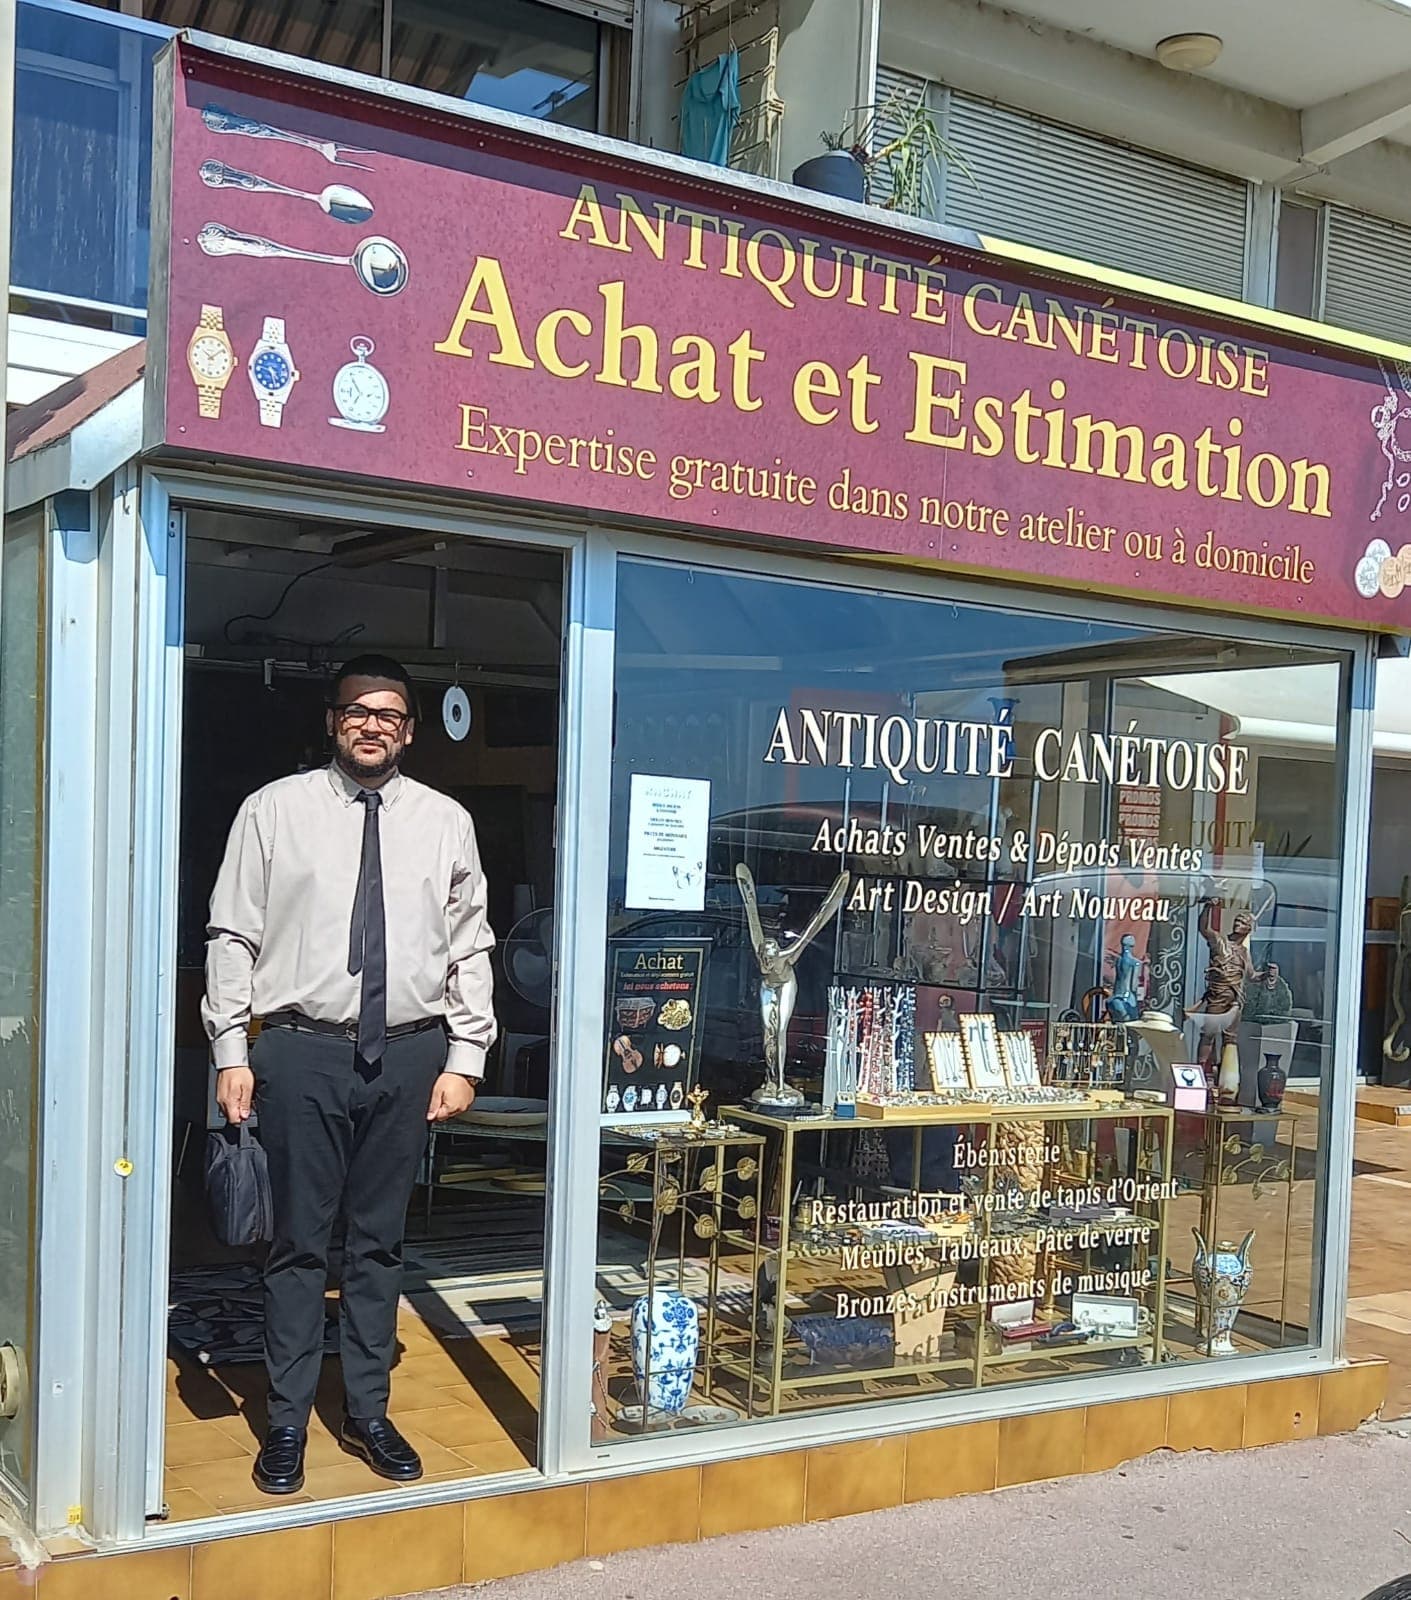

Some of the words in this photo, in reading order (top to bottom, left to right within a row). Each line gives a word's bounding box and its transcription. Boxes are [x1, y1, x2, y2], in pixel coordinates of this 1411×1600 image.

[558, 183, 948, 326] ANTIQUITÉ
[962, 282, 1270, 398] CANÉTOISE
[432, 254, 767, 413] Achat
[792, 353, 883, 435] et
[903, 351, 1333, 518] Estimation
[453, 402, 658, 480] Expertise
[668, 454, 818, 505] gratuite
[827, 467, 909, 521] dans
[919, 495, 1010, 537] notre
[1018, 505, 1117, 553] atelier
[1123, 530, 1163, 561] ou
[1171, 526, 1187, 565] à
[1194, 529, 1315, 584] domicile
[763, 706, 1014, 785] ANTIQUITÉ
[1033, 719, 1250, 795] CANÉTOISE
[811, 817, 907, 857] Achats
[917, 824, 1002, 862] Ventes
[1009, 830, 1031, 864] &
[1036, 830, 1121, 873] Dépots
[1128, 837, 1203, 872] Ventes
[846, 877, 895, 913] Art
[901, 878, 992, 926] Design
[998, 883, 1015, 925] /
[1018, 883, 1063, 919] Art
[1068, 887, 1171, 923] Nouveau
[634, 952, 684, 970] Achat
[952, 1134, 1061, 1169] Ébénisterie
[810, 1190, 943, 1226] Restauration
[949, 1193, 968, 1215] et
[973, 1187, 1025, 1213] vente
[1030, 1183, 1051, 1209] de
[1058, 1178, 1101, 1213] tapis
[1106, 1175, 1179, 1204] d'Orient
[840, 1240, 931, 1271] Meubles,
[937, 1233, 1028, 1262] Tableaux,
[1035, 1227, 1073, 1254] Pâte
[1078, 1223, 1100, 1249] de
[1104, 1225, 1151, 1247] verre
[836, 1292, 922, 1320] Bronzes,
[929, 1276, 1046, 1311] instruments
[1051, 1269, 1073, 1296] de
[1077, 1263, 1152, 1296] musique
